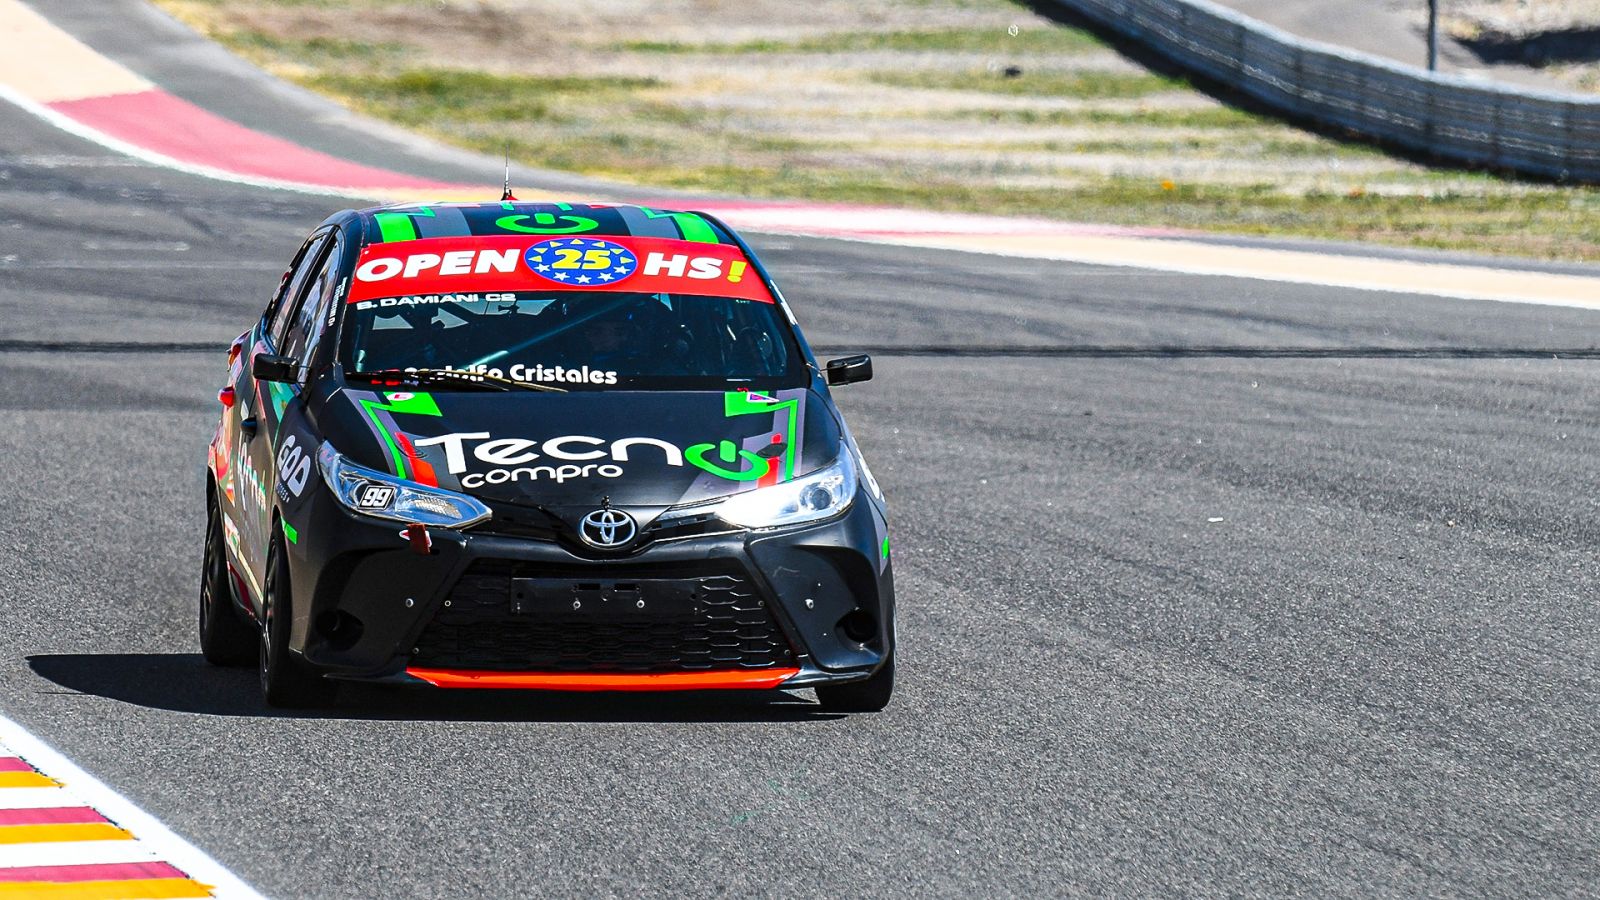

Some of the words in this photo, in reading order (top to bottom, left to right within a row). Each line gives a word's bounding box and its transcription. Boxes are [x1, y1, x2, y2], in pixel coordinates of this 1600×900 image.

[356, 249, 521, 282] OPEN
[551, 248, 612, 270] 25
[380, 293, 479, 307] DAMIANI
[509, 363, 618, 385] Cristales
[461, 463, 623, 488] compro
[361, 487, 390, 507] 99
